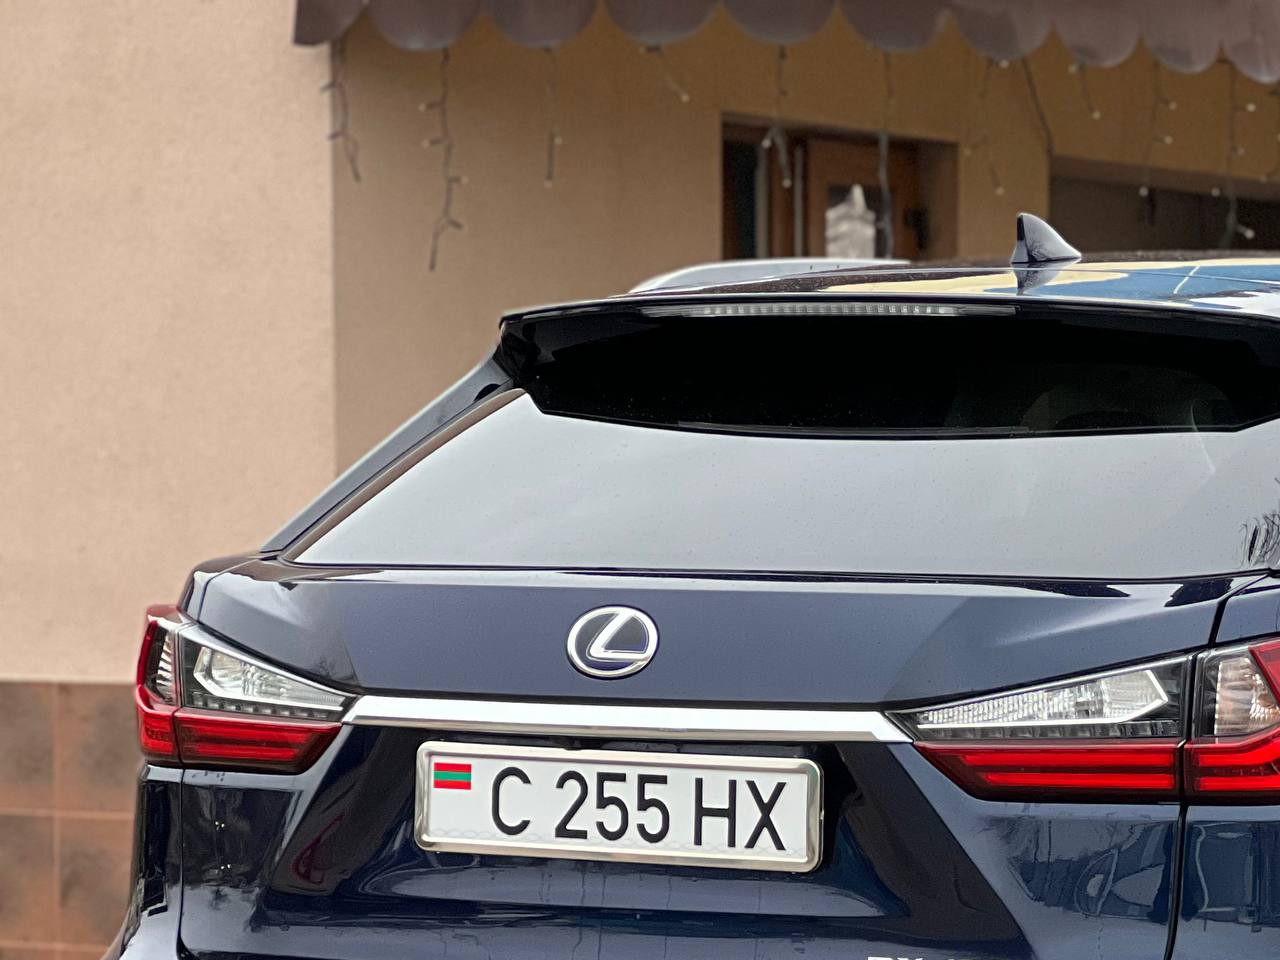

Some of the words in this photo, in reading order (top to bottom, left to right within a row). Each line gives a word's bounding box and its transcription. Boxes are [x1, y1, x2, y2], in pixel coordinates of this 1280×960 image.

[491, 766, 532, 836] C
[555, 770, 670, 844] 255
[694, 777, 787, 851] HX
